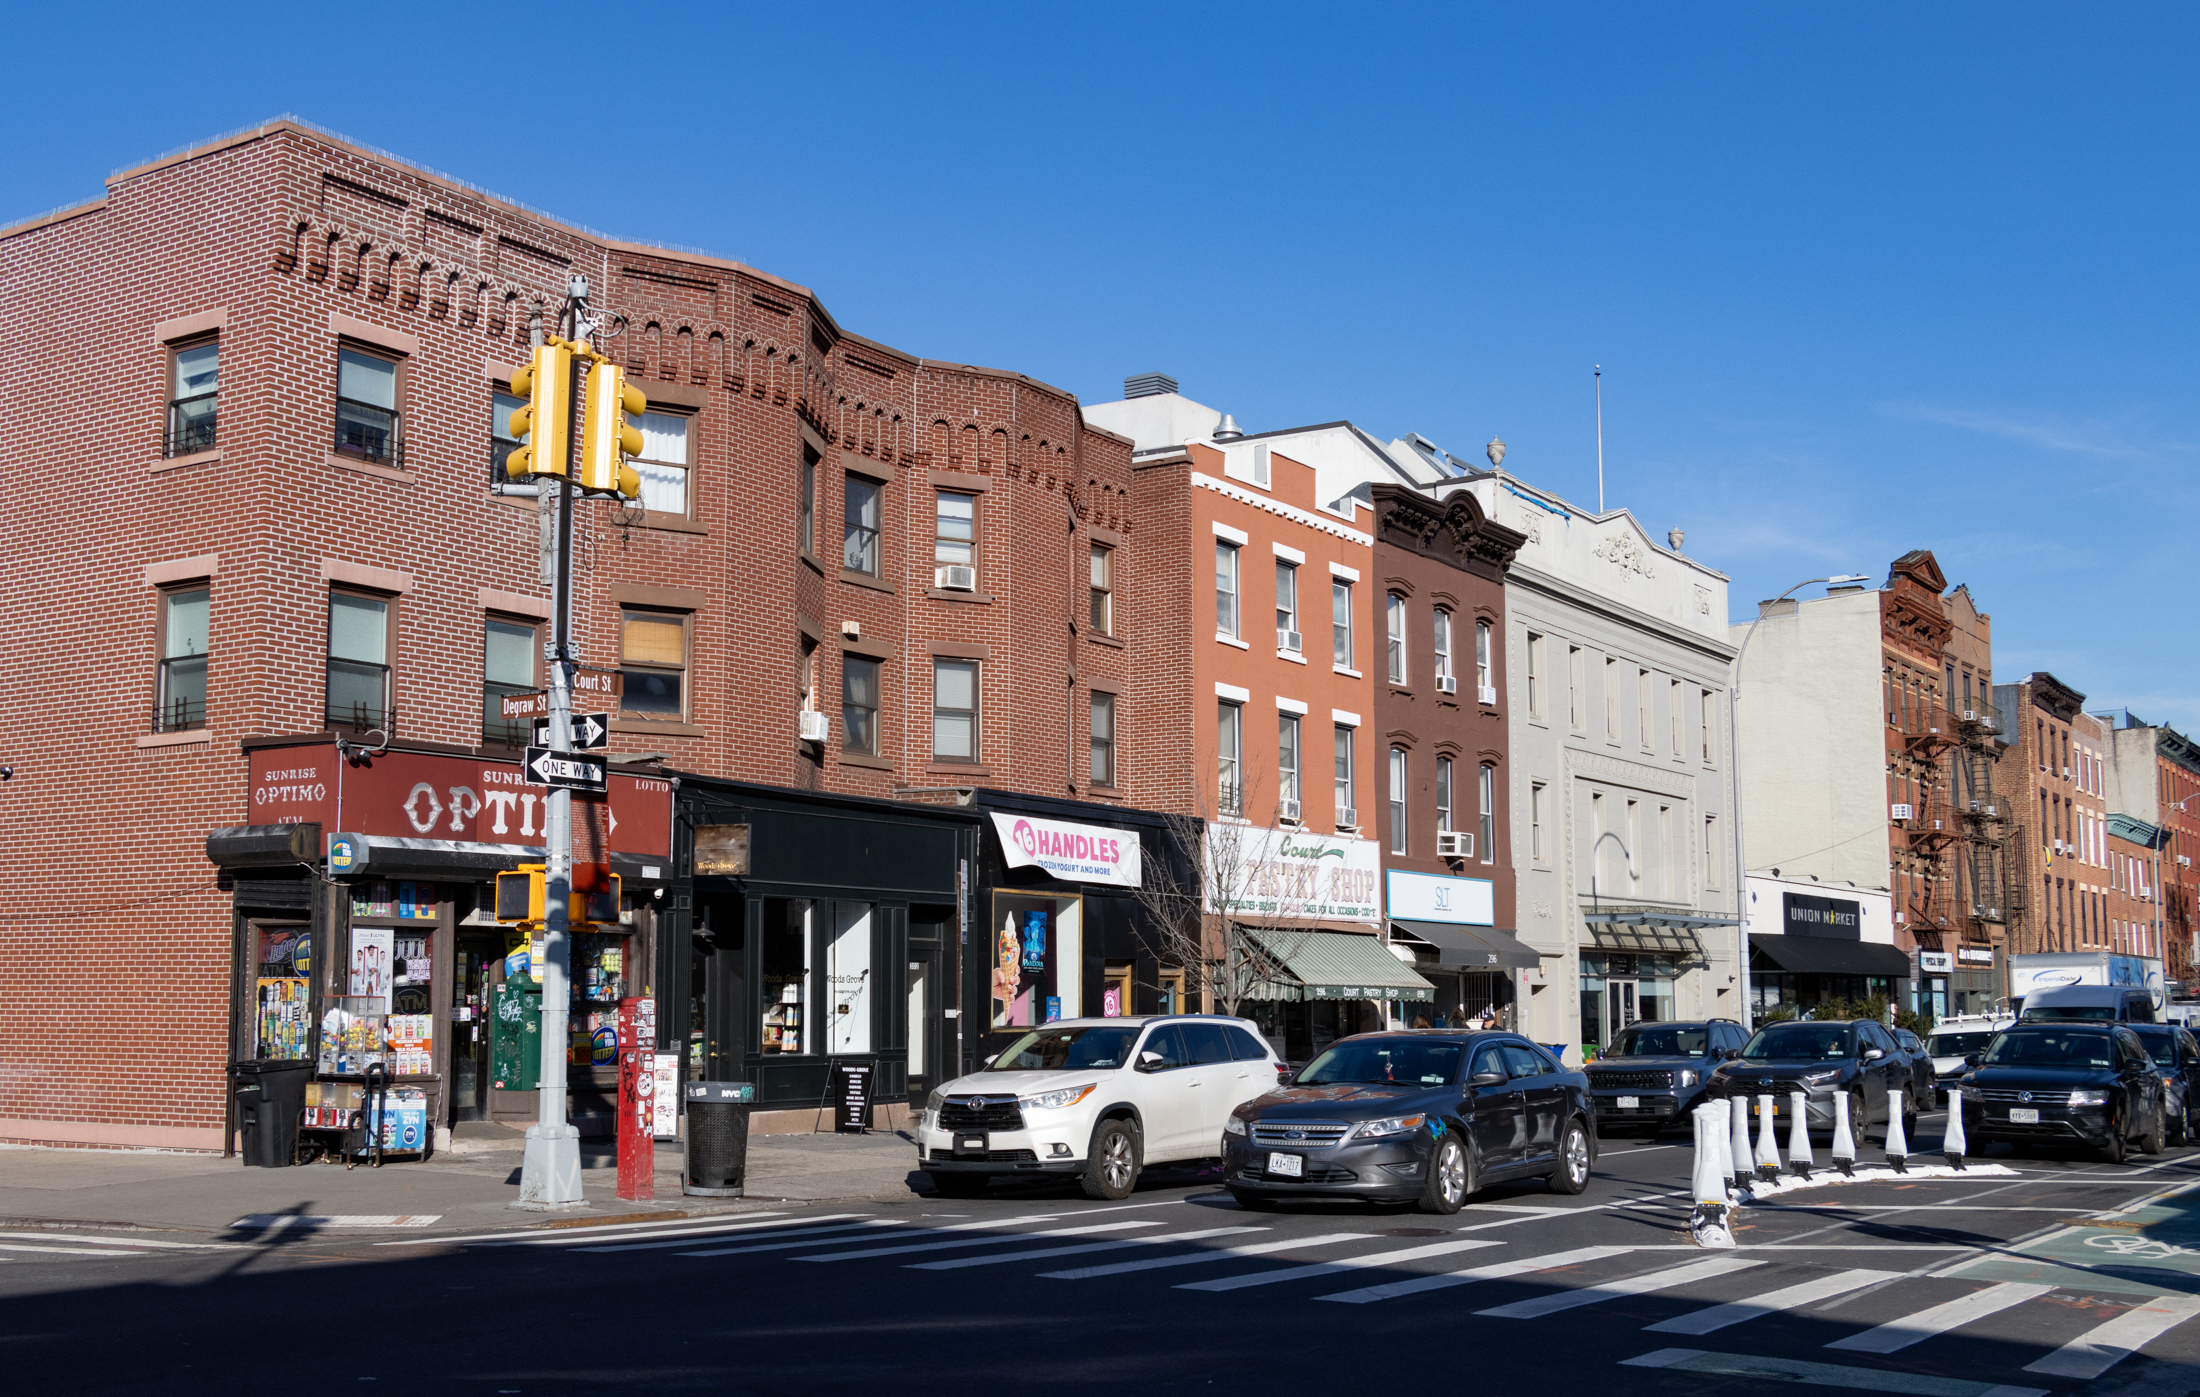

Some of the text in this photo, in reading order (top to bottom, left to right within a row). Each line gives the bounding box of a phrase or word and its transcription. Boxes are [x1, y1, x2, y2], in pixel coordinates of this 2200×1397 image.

[574, 672, 612, 693] Court St
[503, 694, 547, 718] Degraw St
[574, 725, 597, 739] WAY
[265, 767, 317, 782] SUNRISE
[542, 760, 598, 779] ONE WAY
[483, 770, 547, 787] SUNR
[635, 779, 669, 793] LOTTO
[255, 783, 327, 805] OPTIMO
[1015, 826, 1120, 864] 16 HANDLES
[1280, 835, 1330, 859] Court
[1037, 860, 1111, 876] FROZEN YOGURT AND MORE
[1246, 859, 1376, 904] PASTRY SHOP
[1435, 886, 1450, 908] SLT
[1790, 907, 1821, 923] UNION
[1487, 953, 1498, 964] 296
[1343, 986, 1360, 997] COURT
[1363, 987, 1382, 997] PASTRY
[1385, 988, 1399, 998] SHOP
[394, 994, 427, 1011] ATM
[1106, 999, 1114, 1012] 16
[592, 1047, 616, 1060] LOTTERY
[721, 1089, 740, 1098] NYC
[402, 1115, 420, 1125] ZYN
